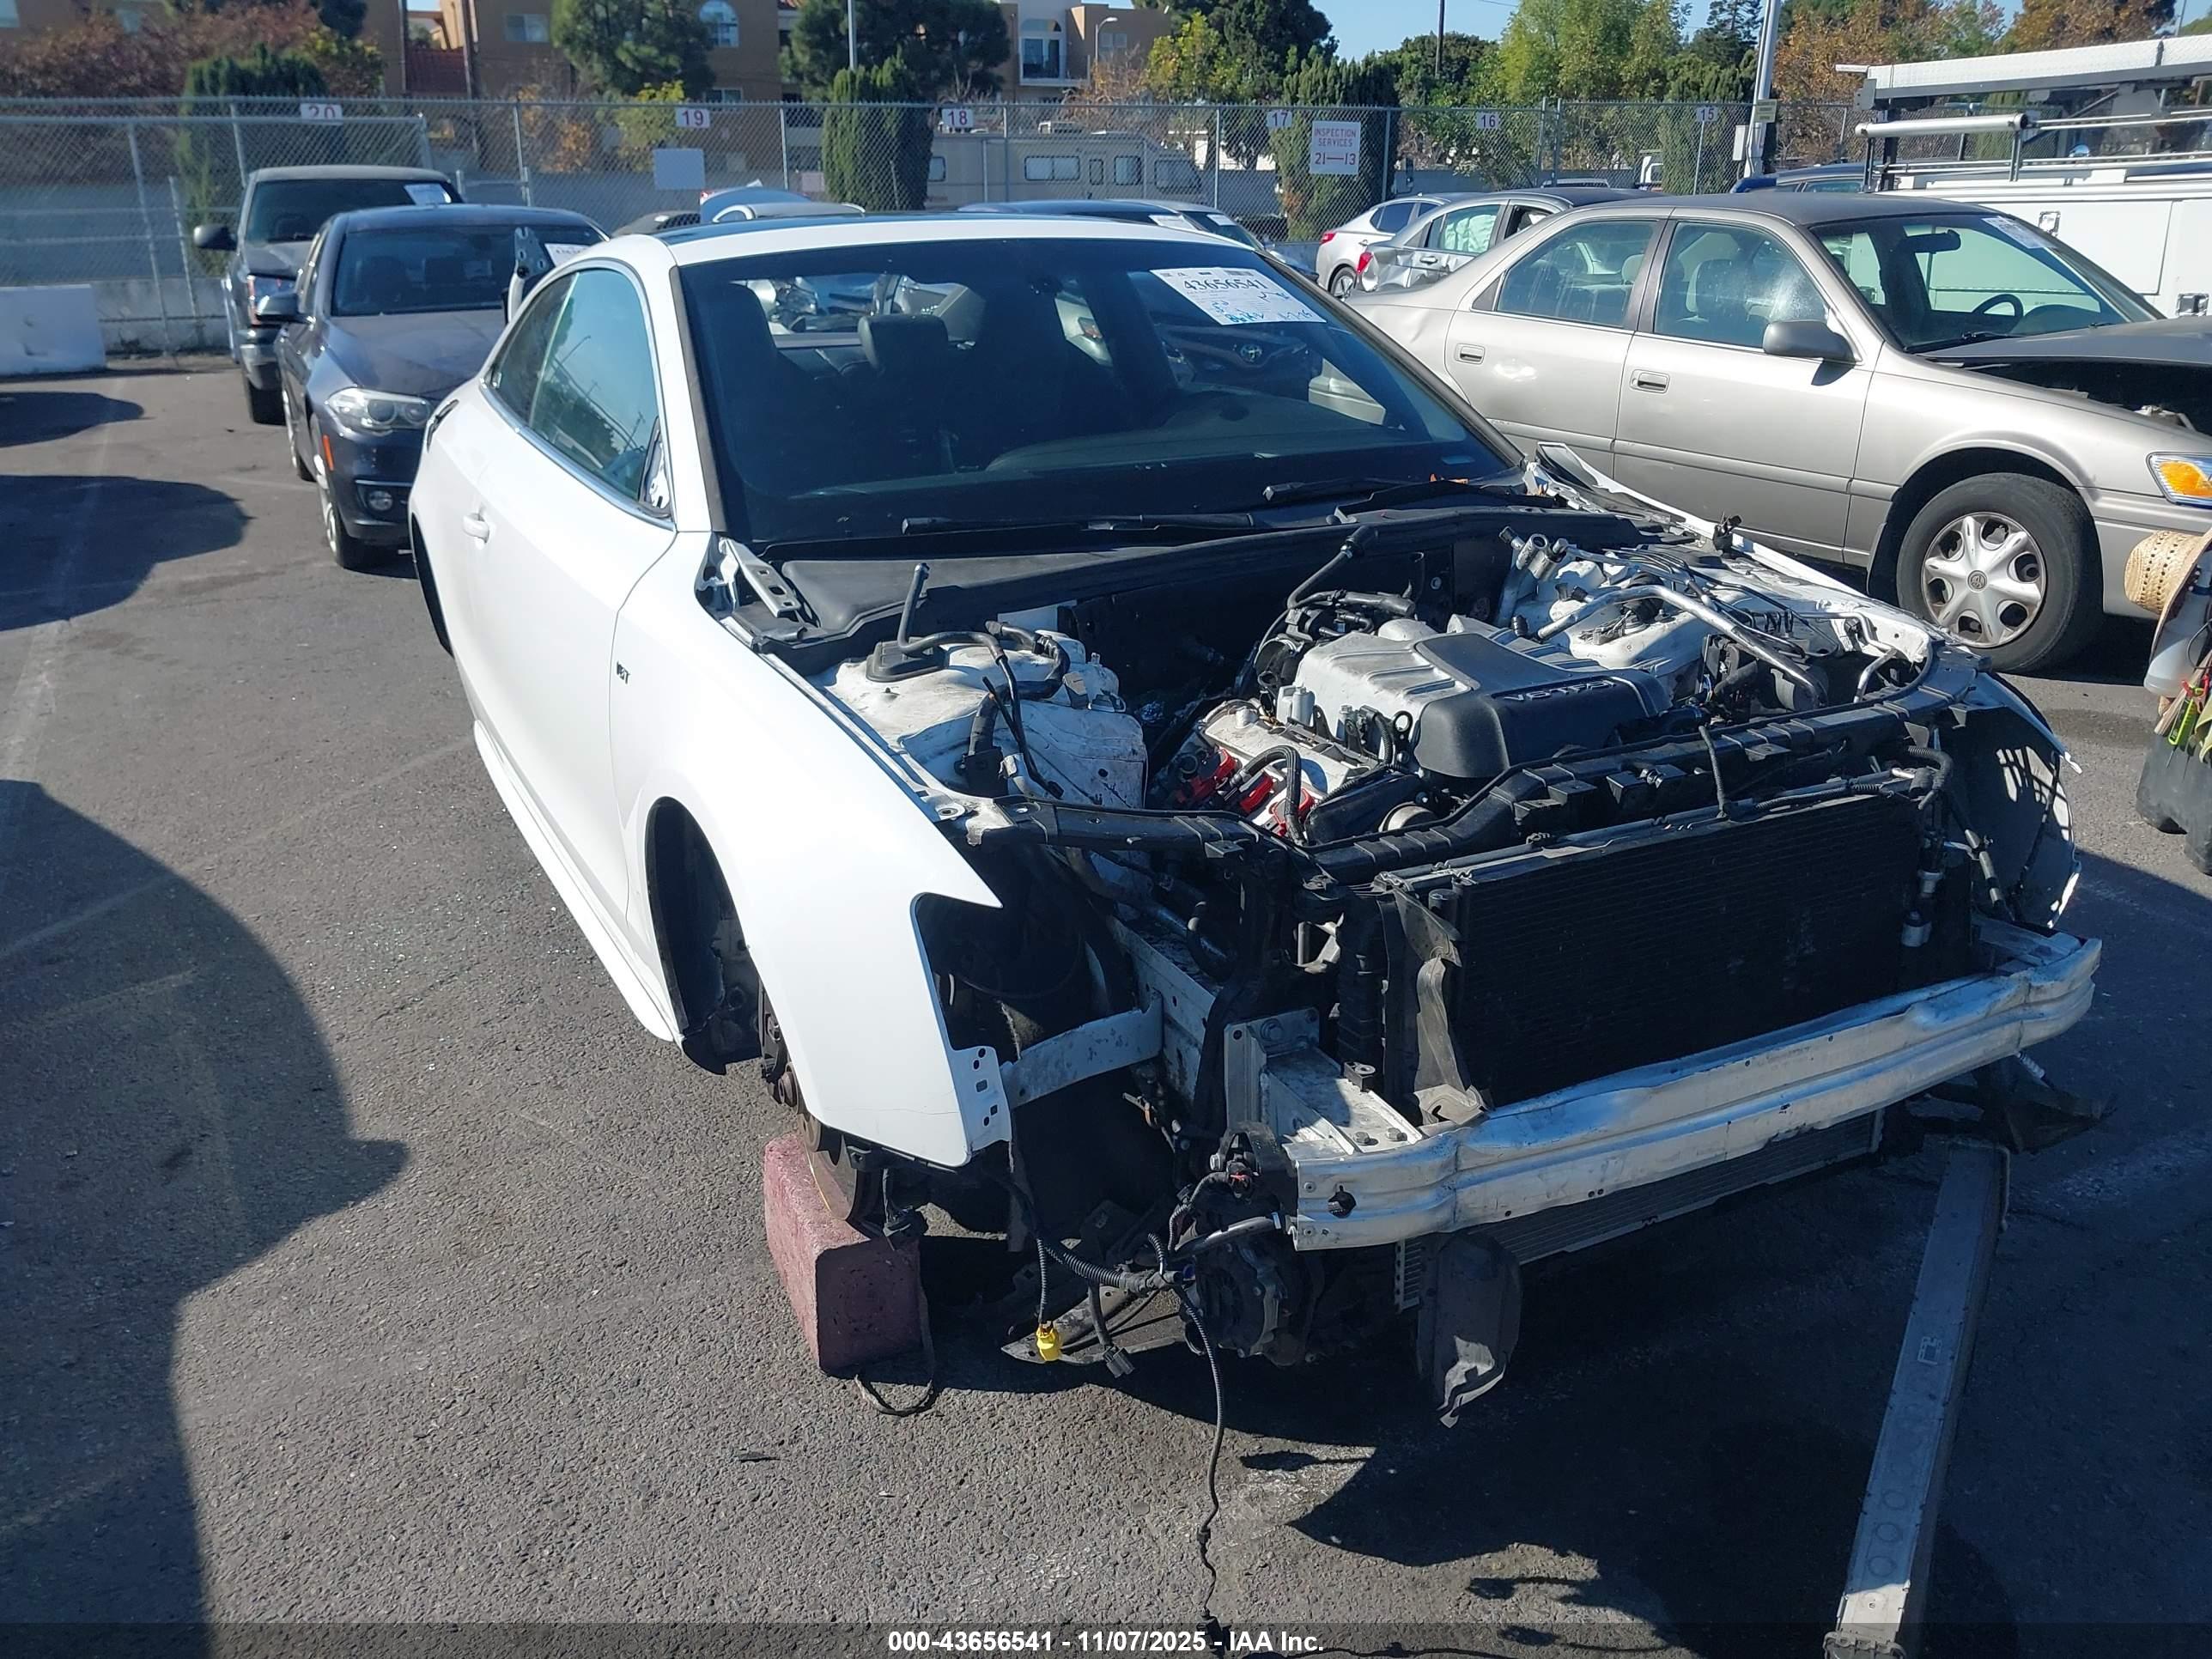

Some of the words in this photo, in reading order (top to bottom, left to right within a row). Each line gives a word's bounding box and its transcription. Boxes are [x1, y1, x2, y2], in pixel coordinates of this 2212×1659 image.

[308, 105, 336, 118] 20
[682, 110, 703, 126] 19
[948, 110, 968, 125] 18
[1700, 108, 1715, 120] 15
[1272, 112, 1288, 126] 17
[1481, 114, 1496, 128] 16
[1314, 128, 1357, 137] INSPECTION
[1318, 137, 1353, 147] SERVICES
[1183, 278, 1268, 290] 43656541
